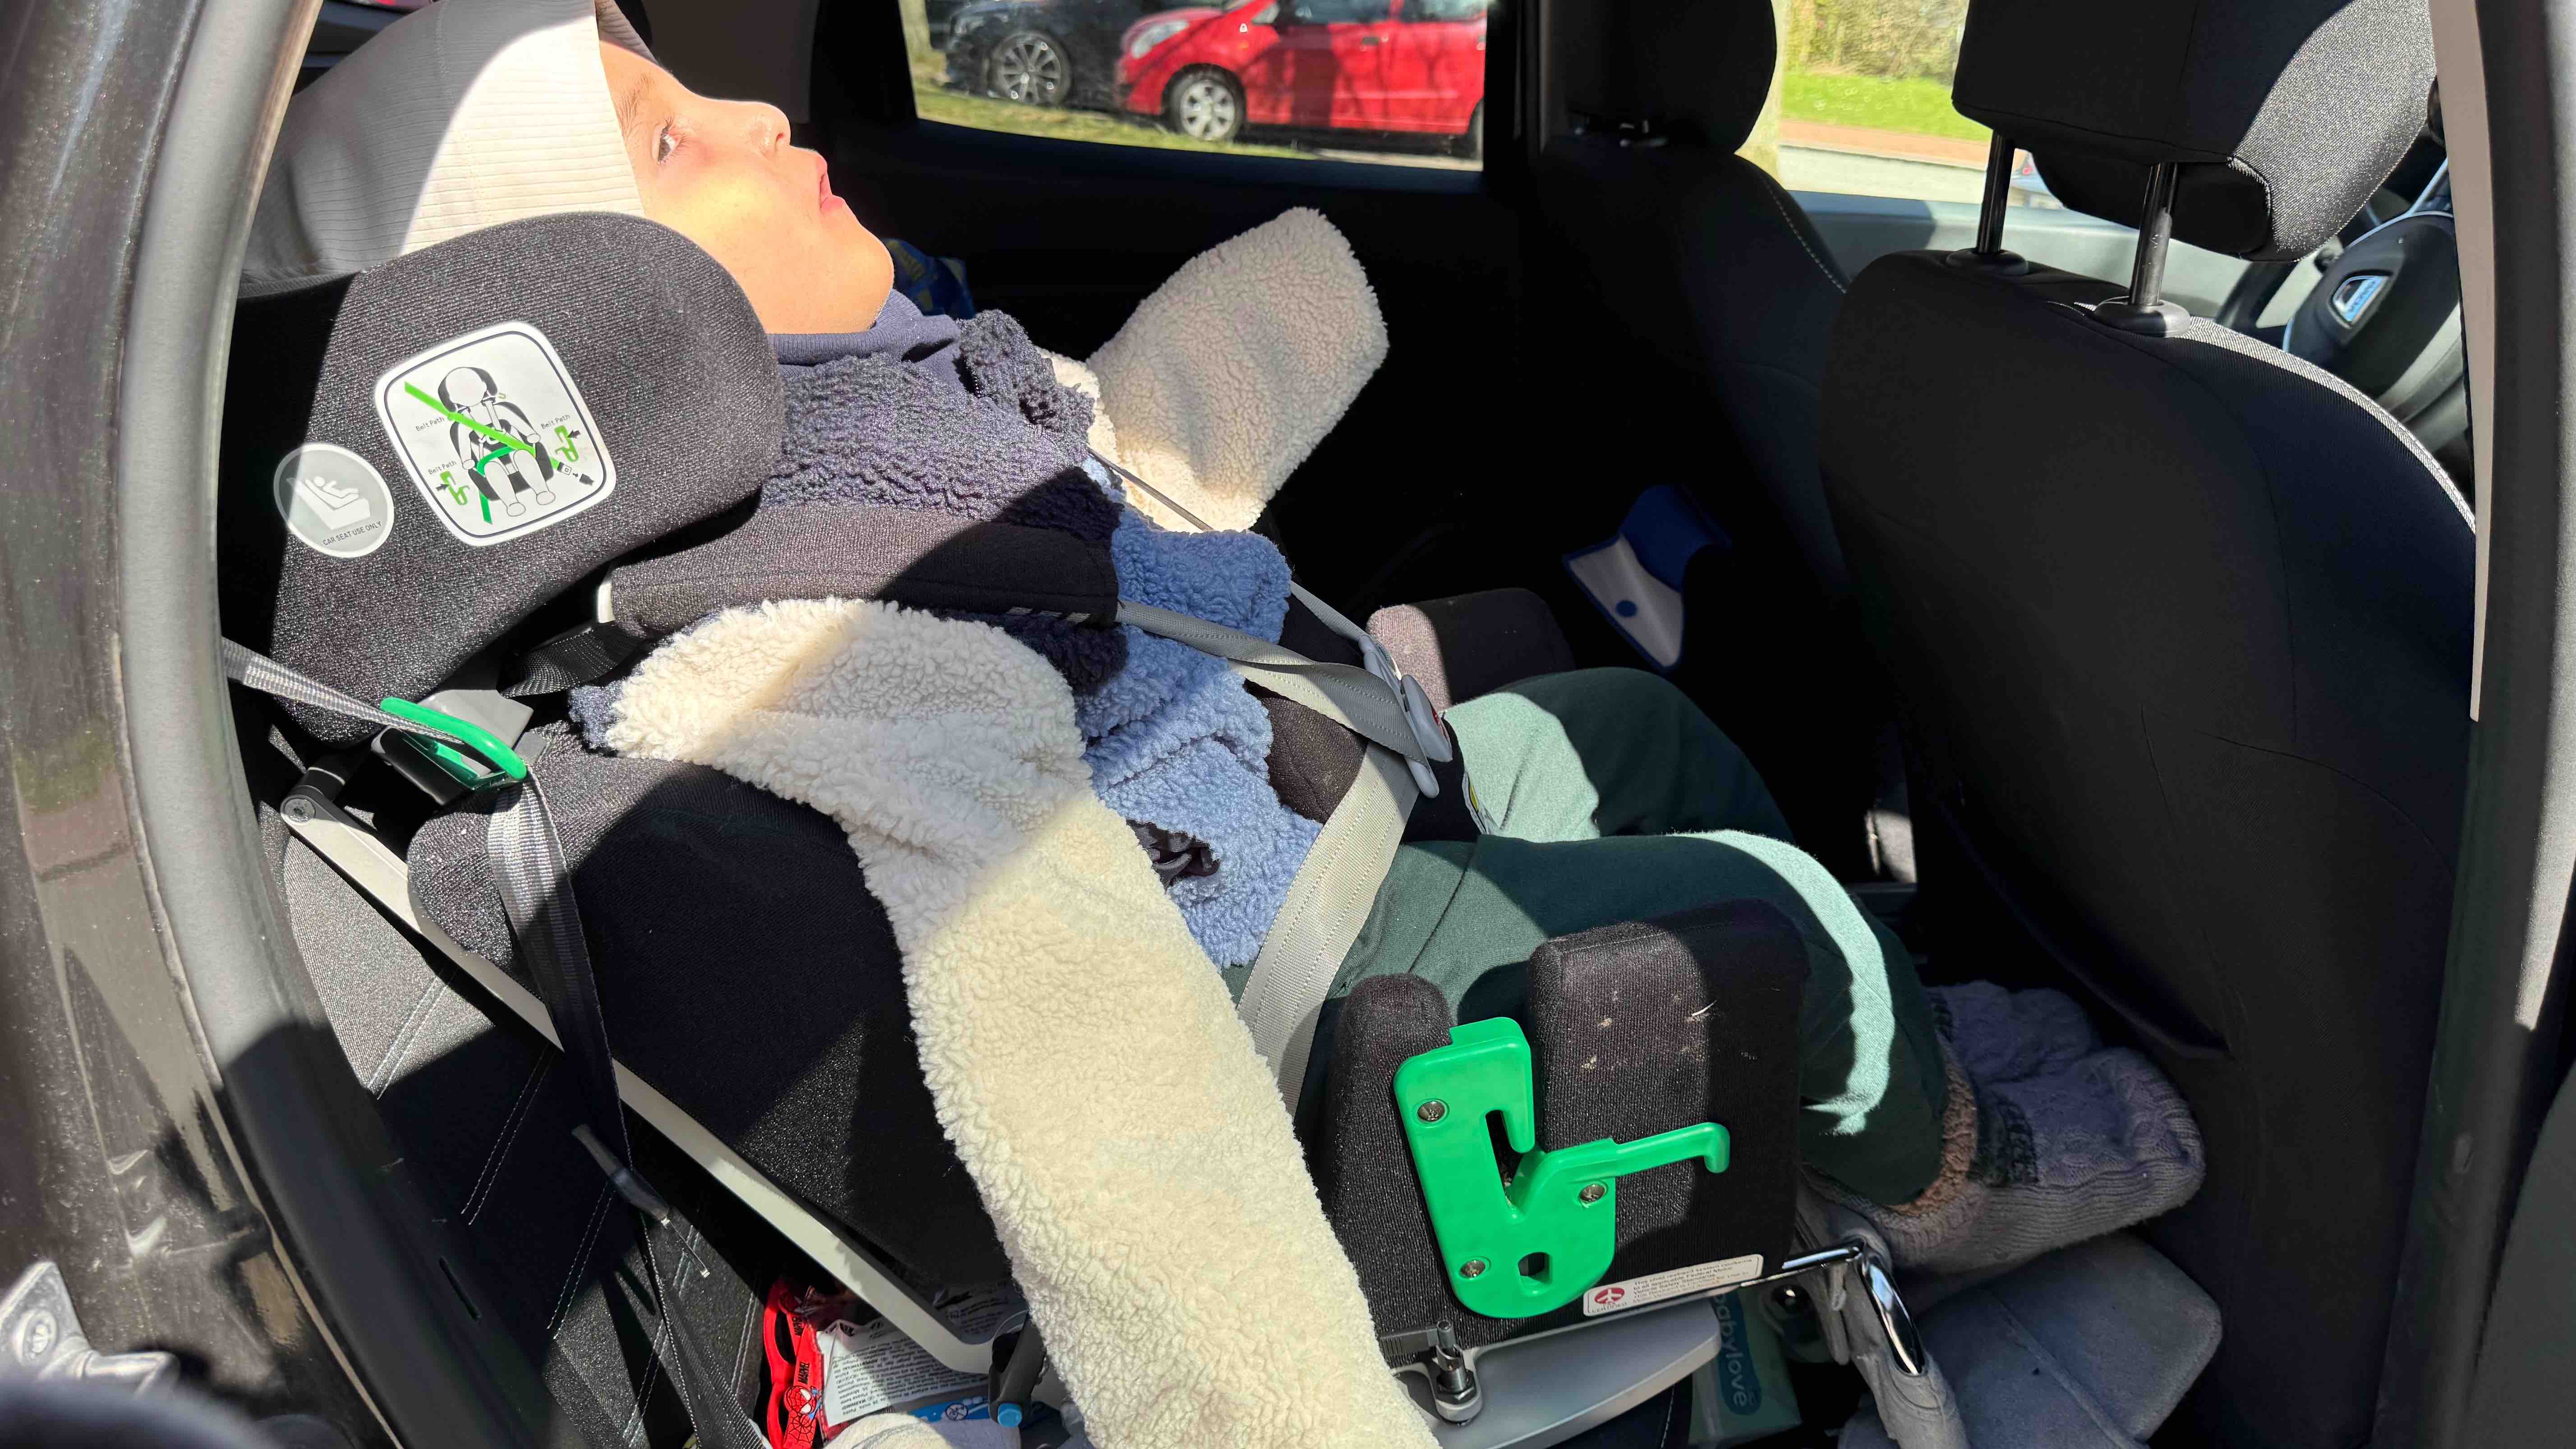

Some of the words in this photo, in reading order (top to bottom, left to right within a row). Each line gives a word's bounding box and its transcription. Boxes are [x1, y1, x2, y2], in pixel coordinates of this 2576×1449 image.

[429, 417, 444, 426] Path
[555, 414, 570, 423] Path
[442, 461, 457, 469] Path
[322, 536, 336, 546] CAR
[336, 531, 351, 541] SEAT
[352, 526, 365, 536] USE
[365, 521, 382, 531] ONLY
